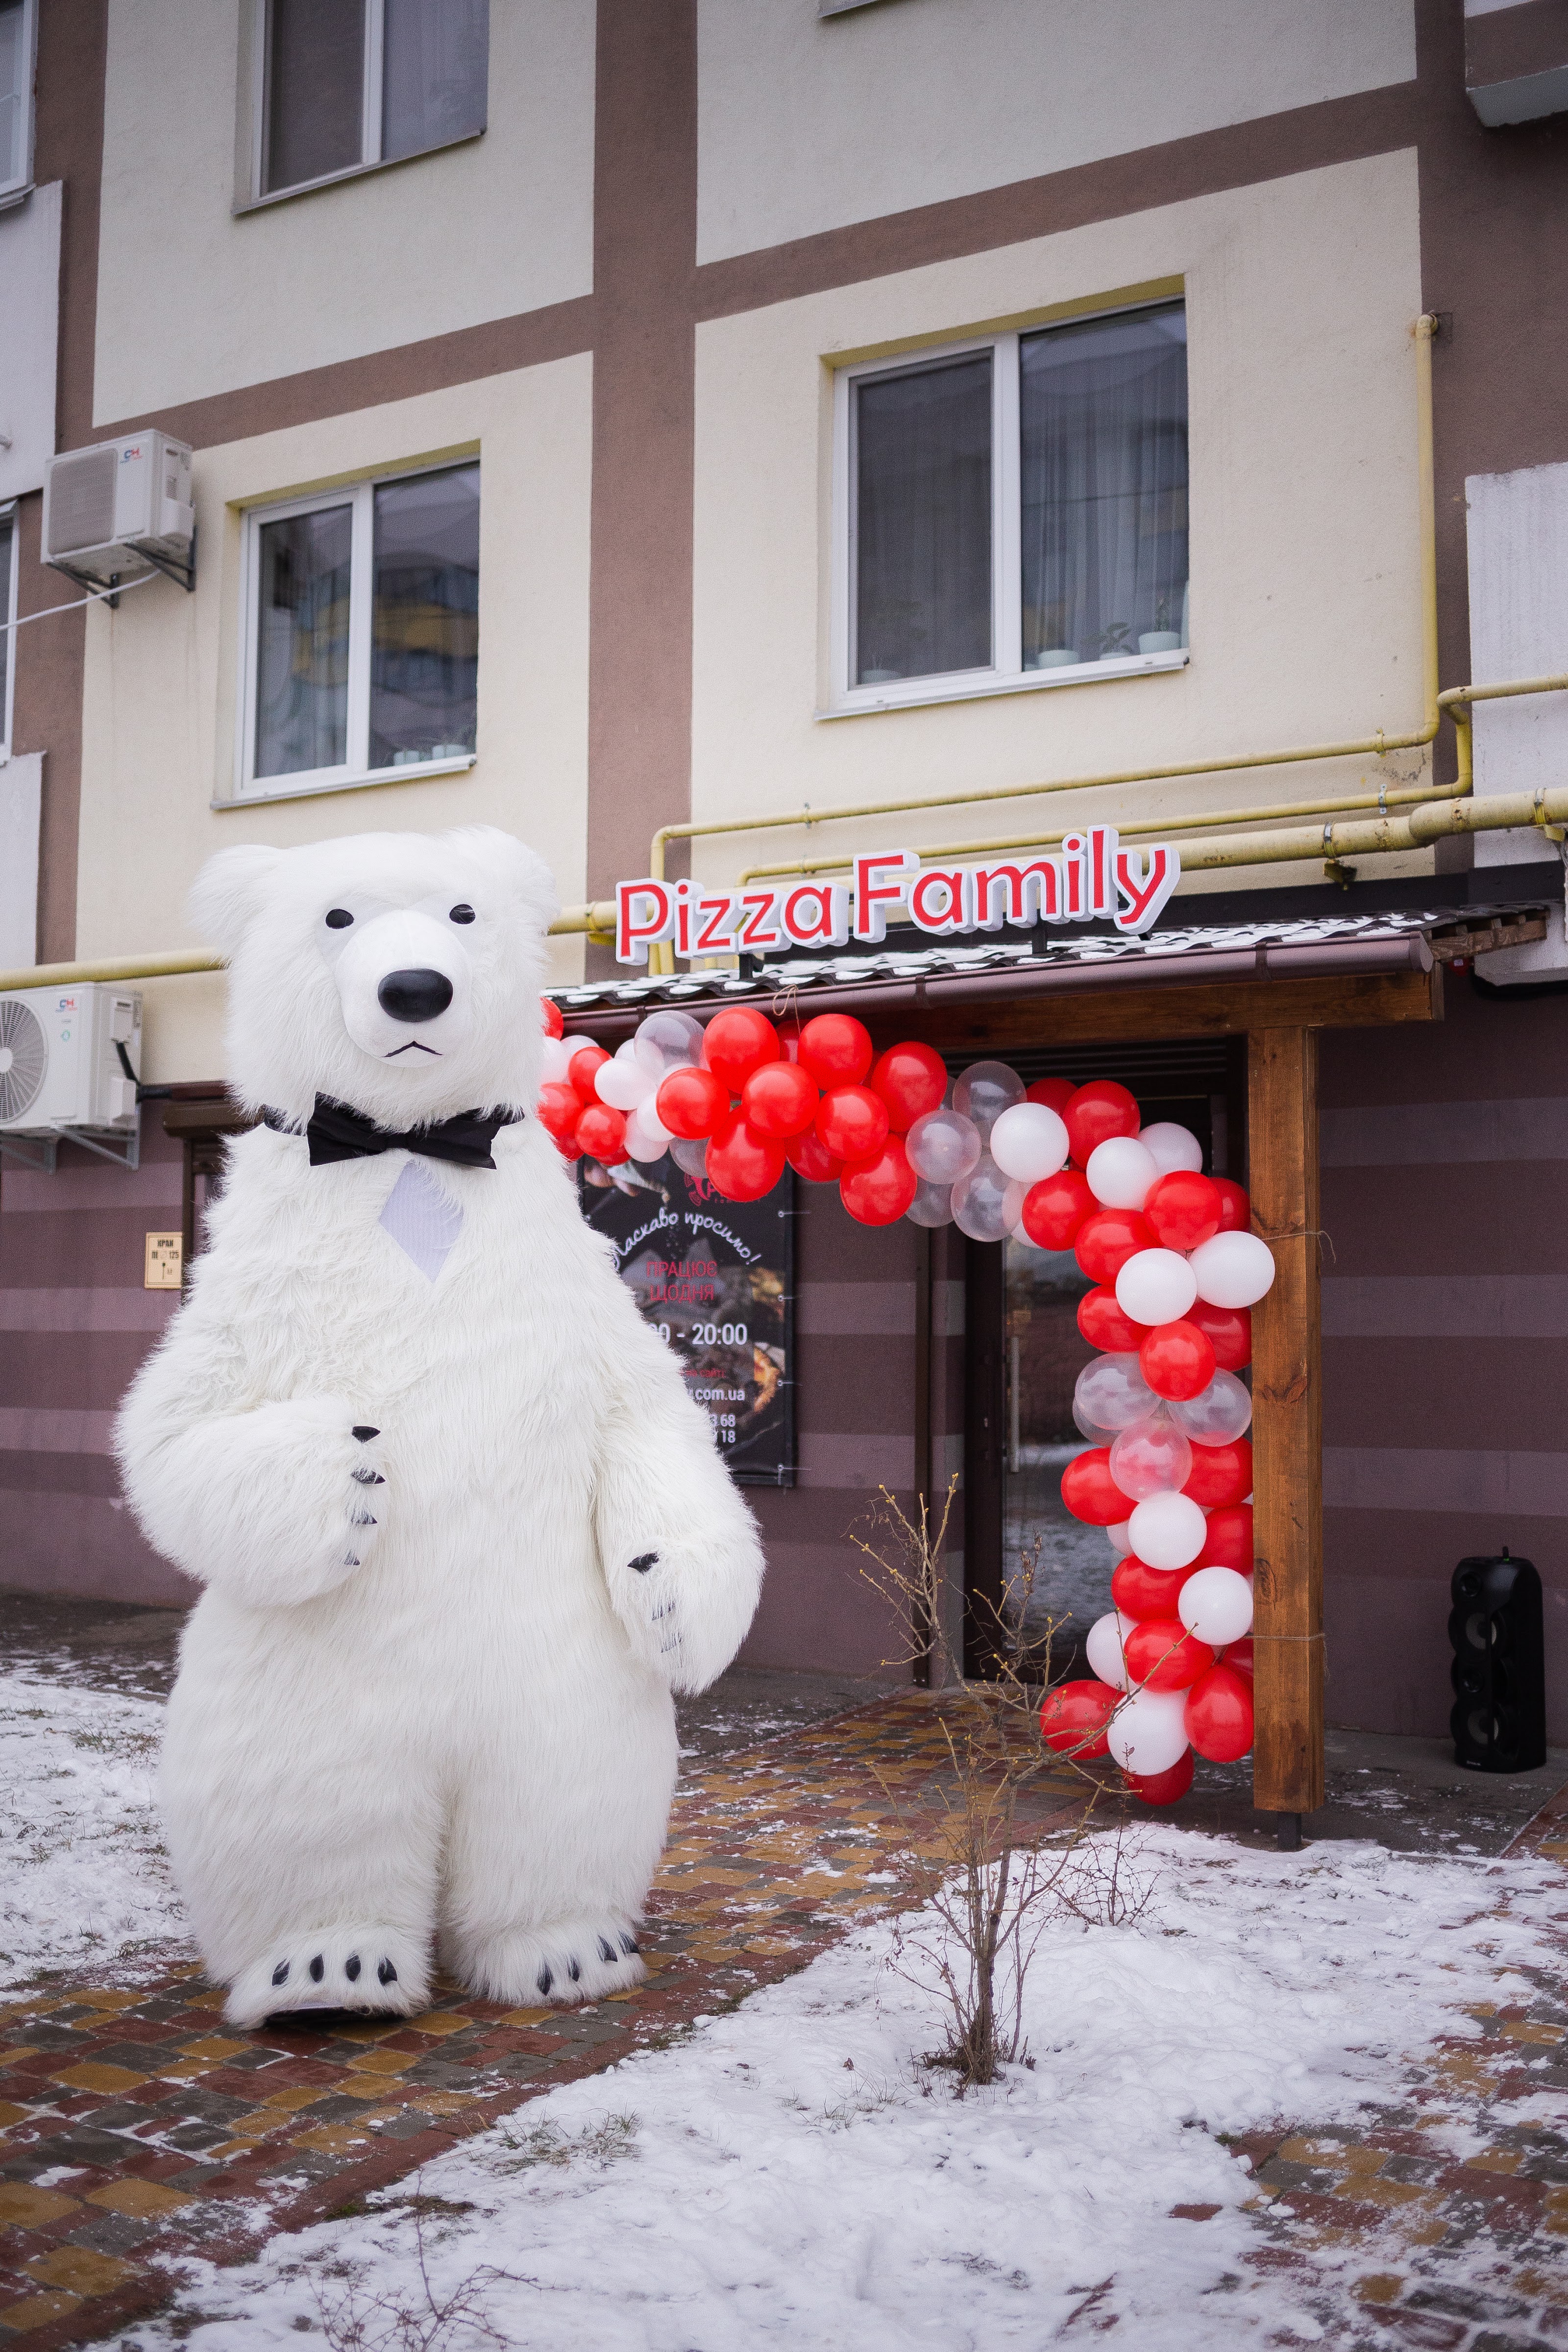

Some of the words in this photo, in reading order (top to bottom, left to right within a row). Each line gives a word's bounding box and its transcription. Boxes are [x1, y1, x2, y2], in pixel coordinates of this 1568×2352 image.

[616, 878, 846, 963] Pizza
[854, 824, 1179, 942] Family
[685, 1212, 761, 1265] просимо!
[646, 1260, 718, 1280] ПРАЦЮЄ
[650, 1284, 714, 1304] ЩОДНЯ
[692, 1323, 748, 1345] 20:00
[688, 1388, 745, 1400] com.ua
[720, 1414, 735, 1427] 68
[721, 1429, 735, 1443] 18
